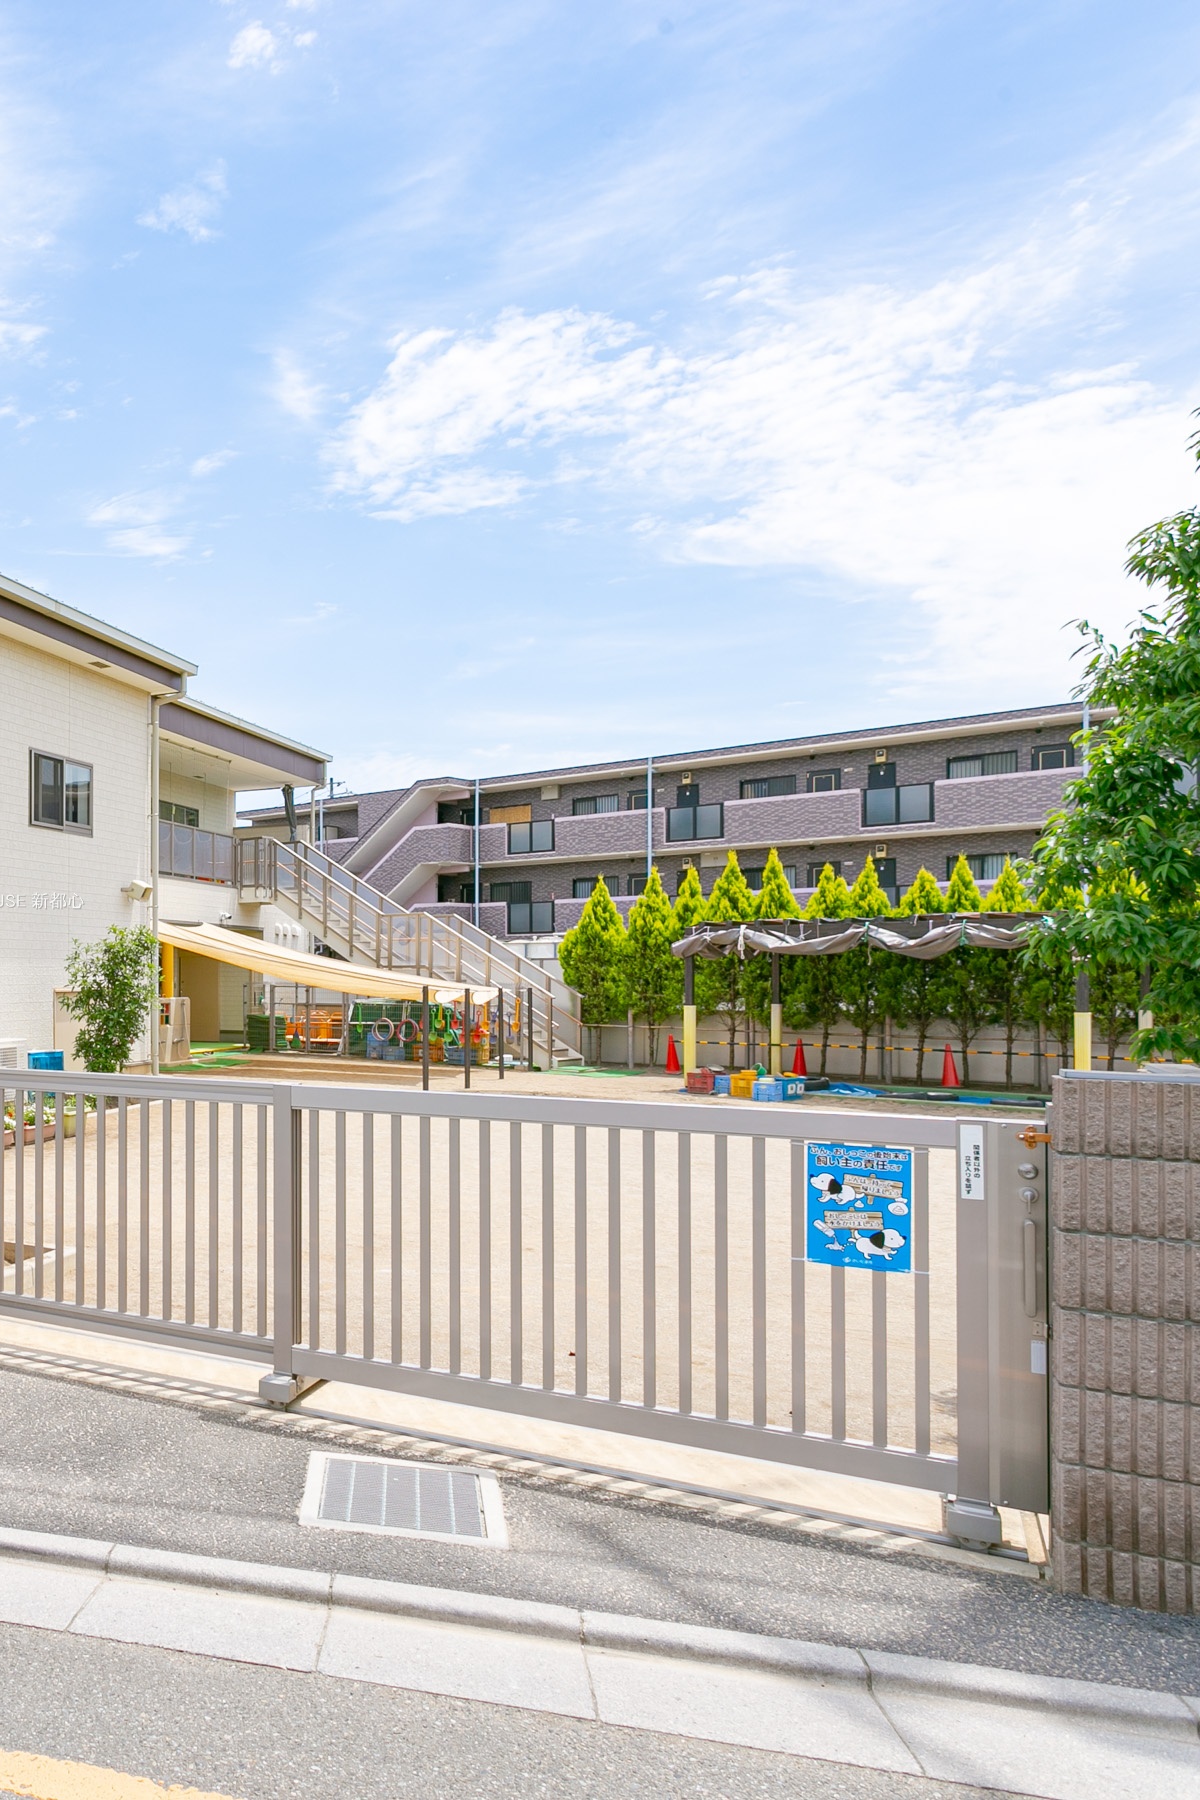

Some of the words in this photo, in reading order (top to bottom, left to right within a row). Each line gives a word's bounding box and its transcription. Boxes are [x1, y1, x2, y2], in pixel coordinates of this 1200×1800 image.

[810, 1145, 909, 1161] ふん、おしっこの後始末は
[816, 1155, 903, 1171] 飼い主の責任です
[973, 1144, 981, 1179] 関係者以外の
[964, 1155, 972, 1195] 立ち入りを禁ず
